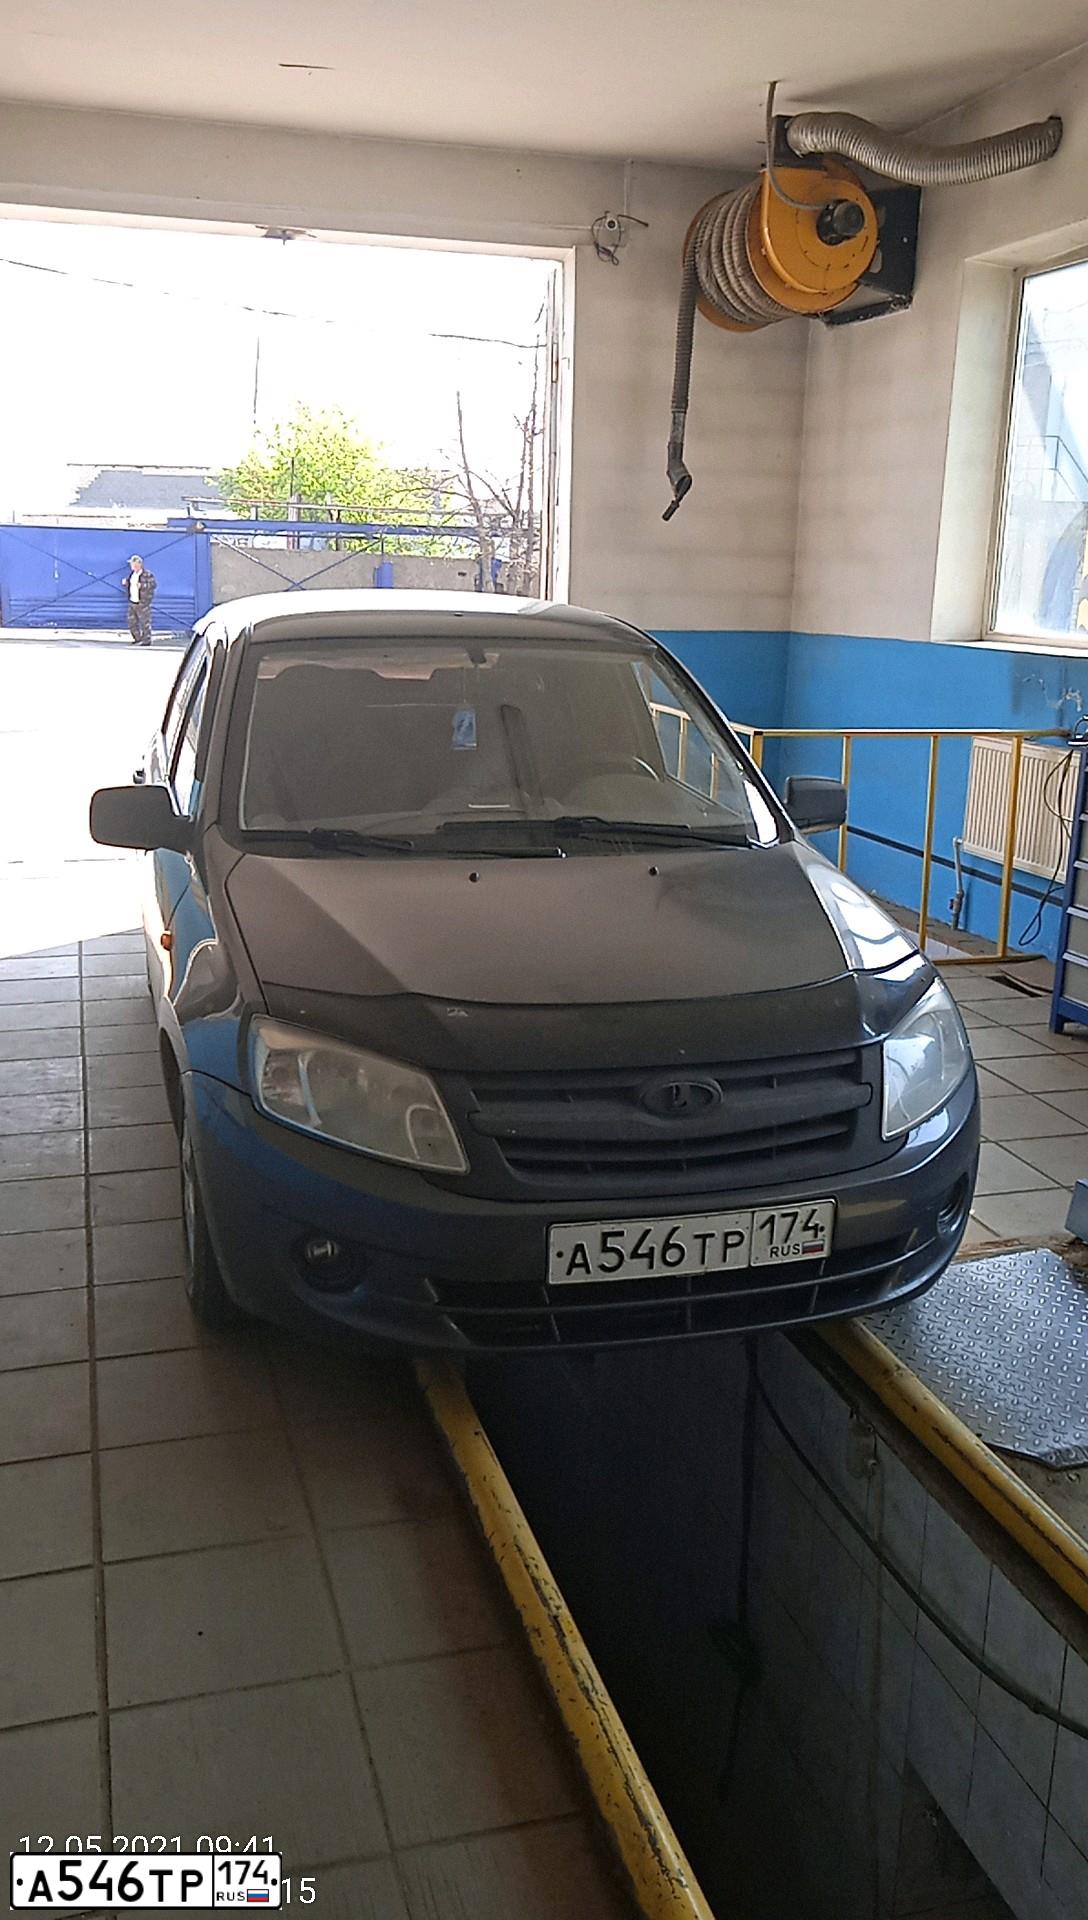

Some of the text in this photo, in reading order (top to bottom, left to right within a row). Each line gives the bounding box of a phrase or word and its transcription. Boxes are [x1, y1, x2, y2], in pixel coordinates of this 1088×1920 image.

[565, 1208, 818, 1276] А546ТР 174
[769, 1243, 801, 1258] RUS
